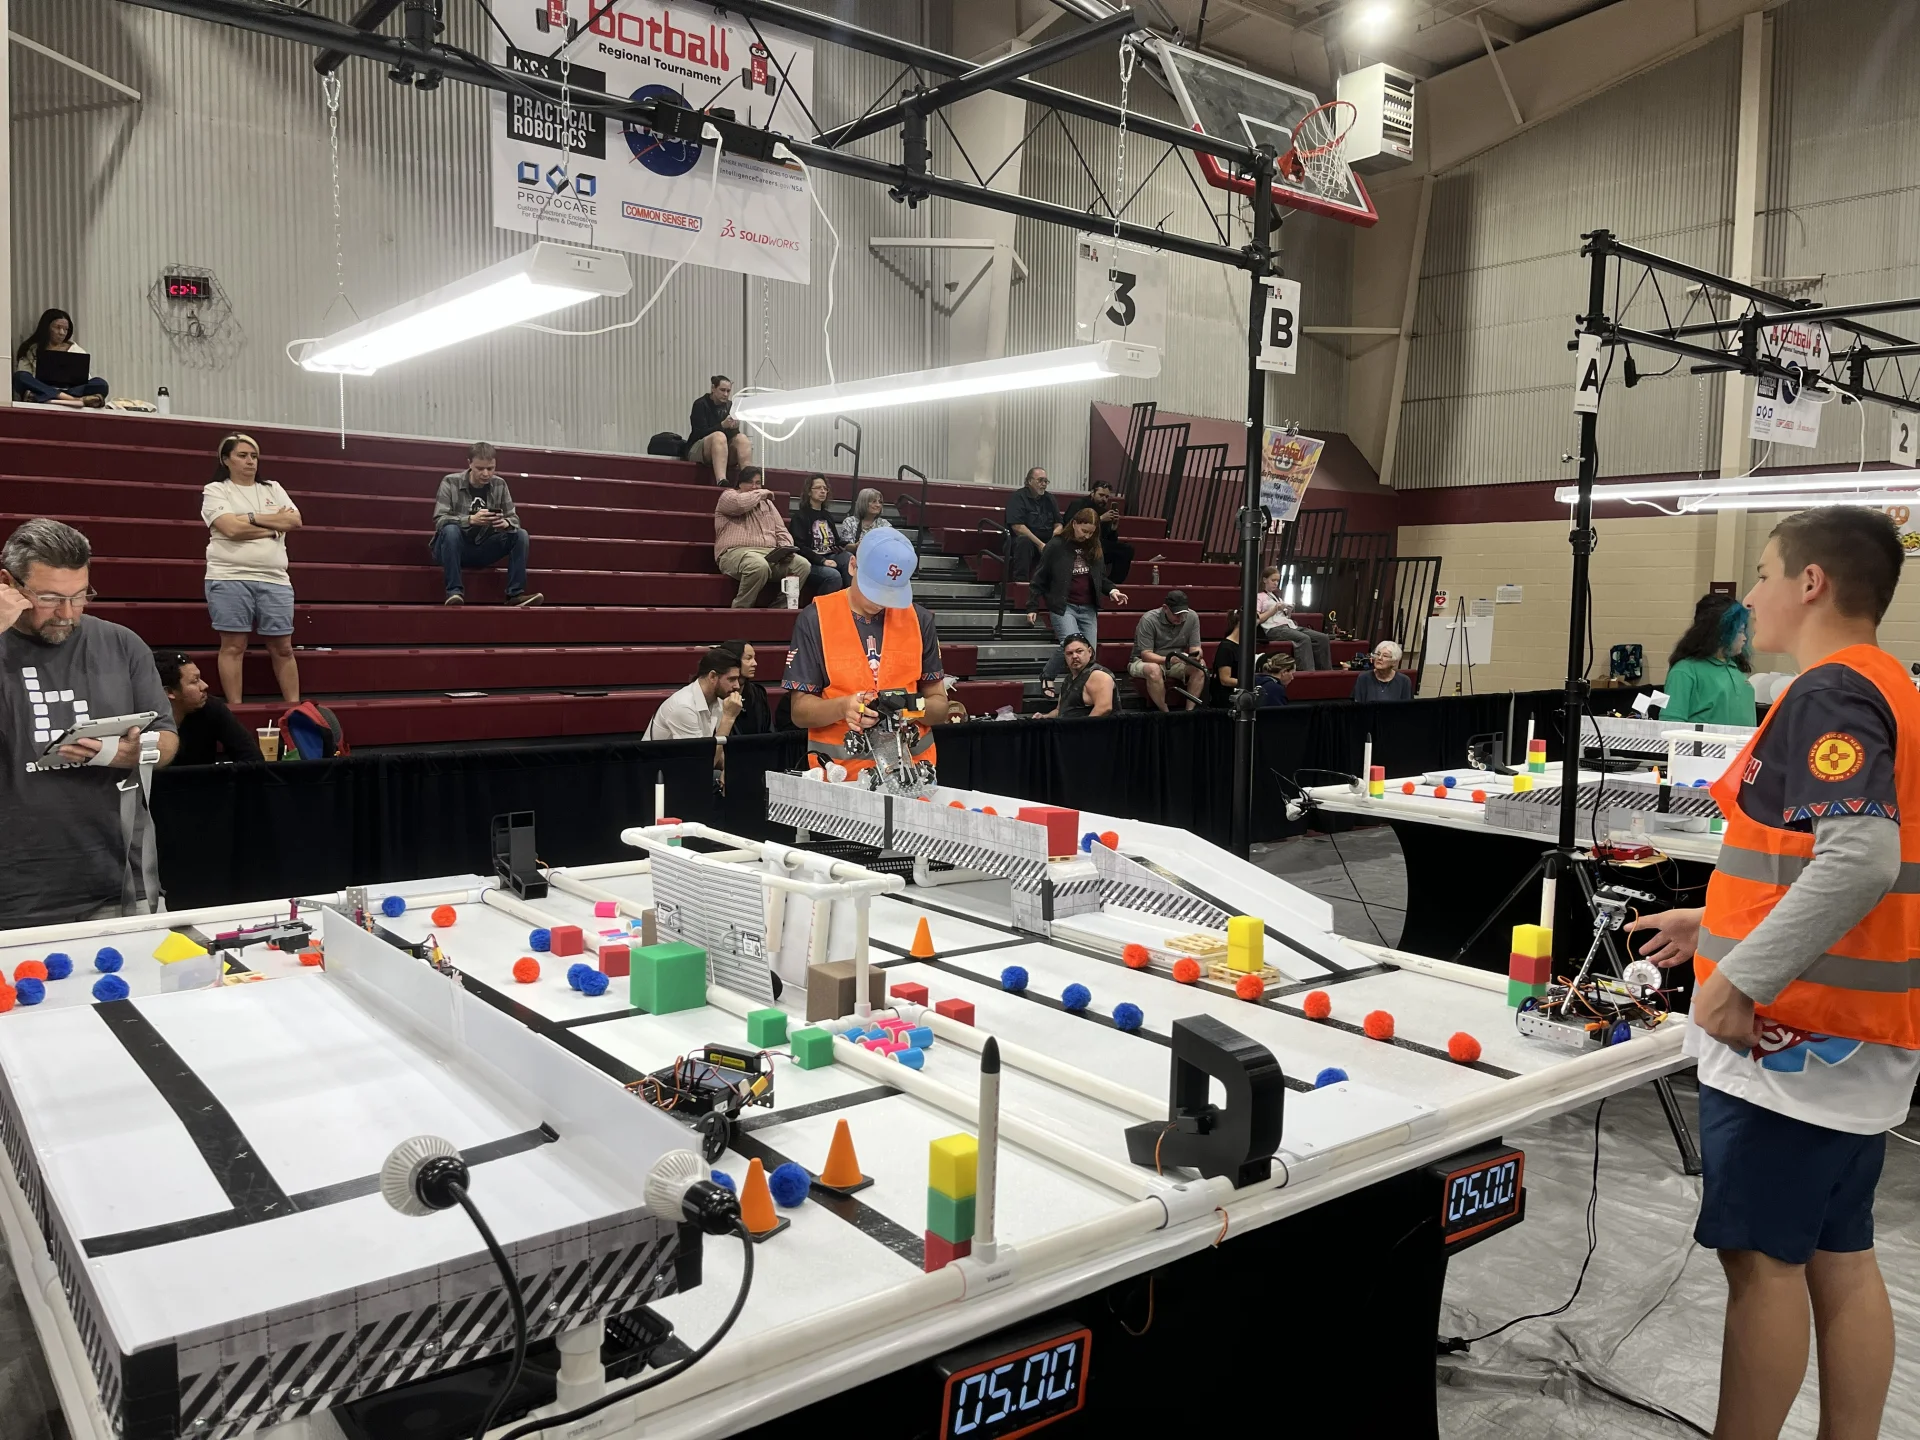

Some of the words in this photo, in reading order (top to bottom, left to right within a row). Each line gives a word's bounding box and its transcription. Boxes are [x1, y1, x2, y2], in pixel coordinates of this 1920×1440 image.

[589, 0, 729, 71] Botball
[598, 42, 651, 66] Regional
[653, 57, 722, 86] Tournament
[513, 95, 596, 133] PRACTICAL
[513, 114, 587, 149] ROBOTICS
[517, 191, 597, 216] PROTOCASE
[517, 203, 539, 214] Custom
[625, 205, 661, 222] COMMON
[661, 211, 687, 227] SENSE
[687, 217, 700, 230] RC
[739, 230, 800, 252] SOLIDWORKS
[1105, 268, 1137, 327] 3
[1269, 307, 1293, 349] B
[1579, 358, 1599, 394] A
[1271, 438, 1308, 462] Botball
[1898, 422, 1909, 453] 2
